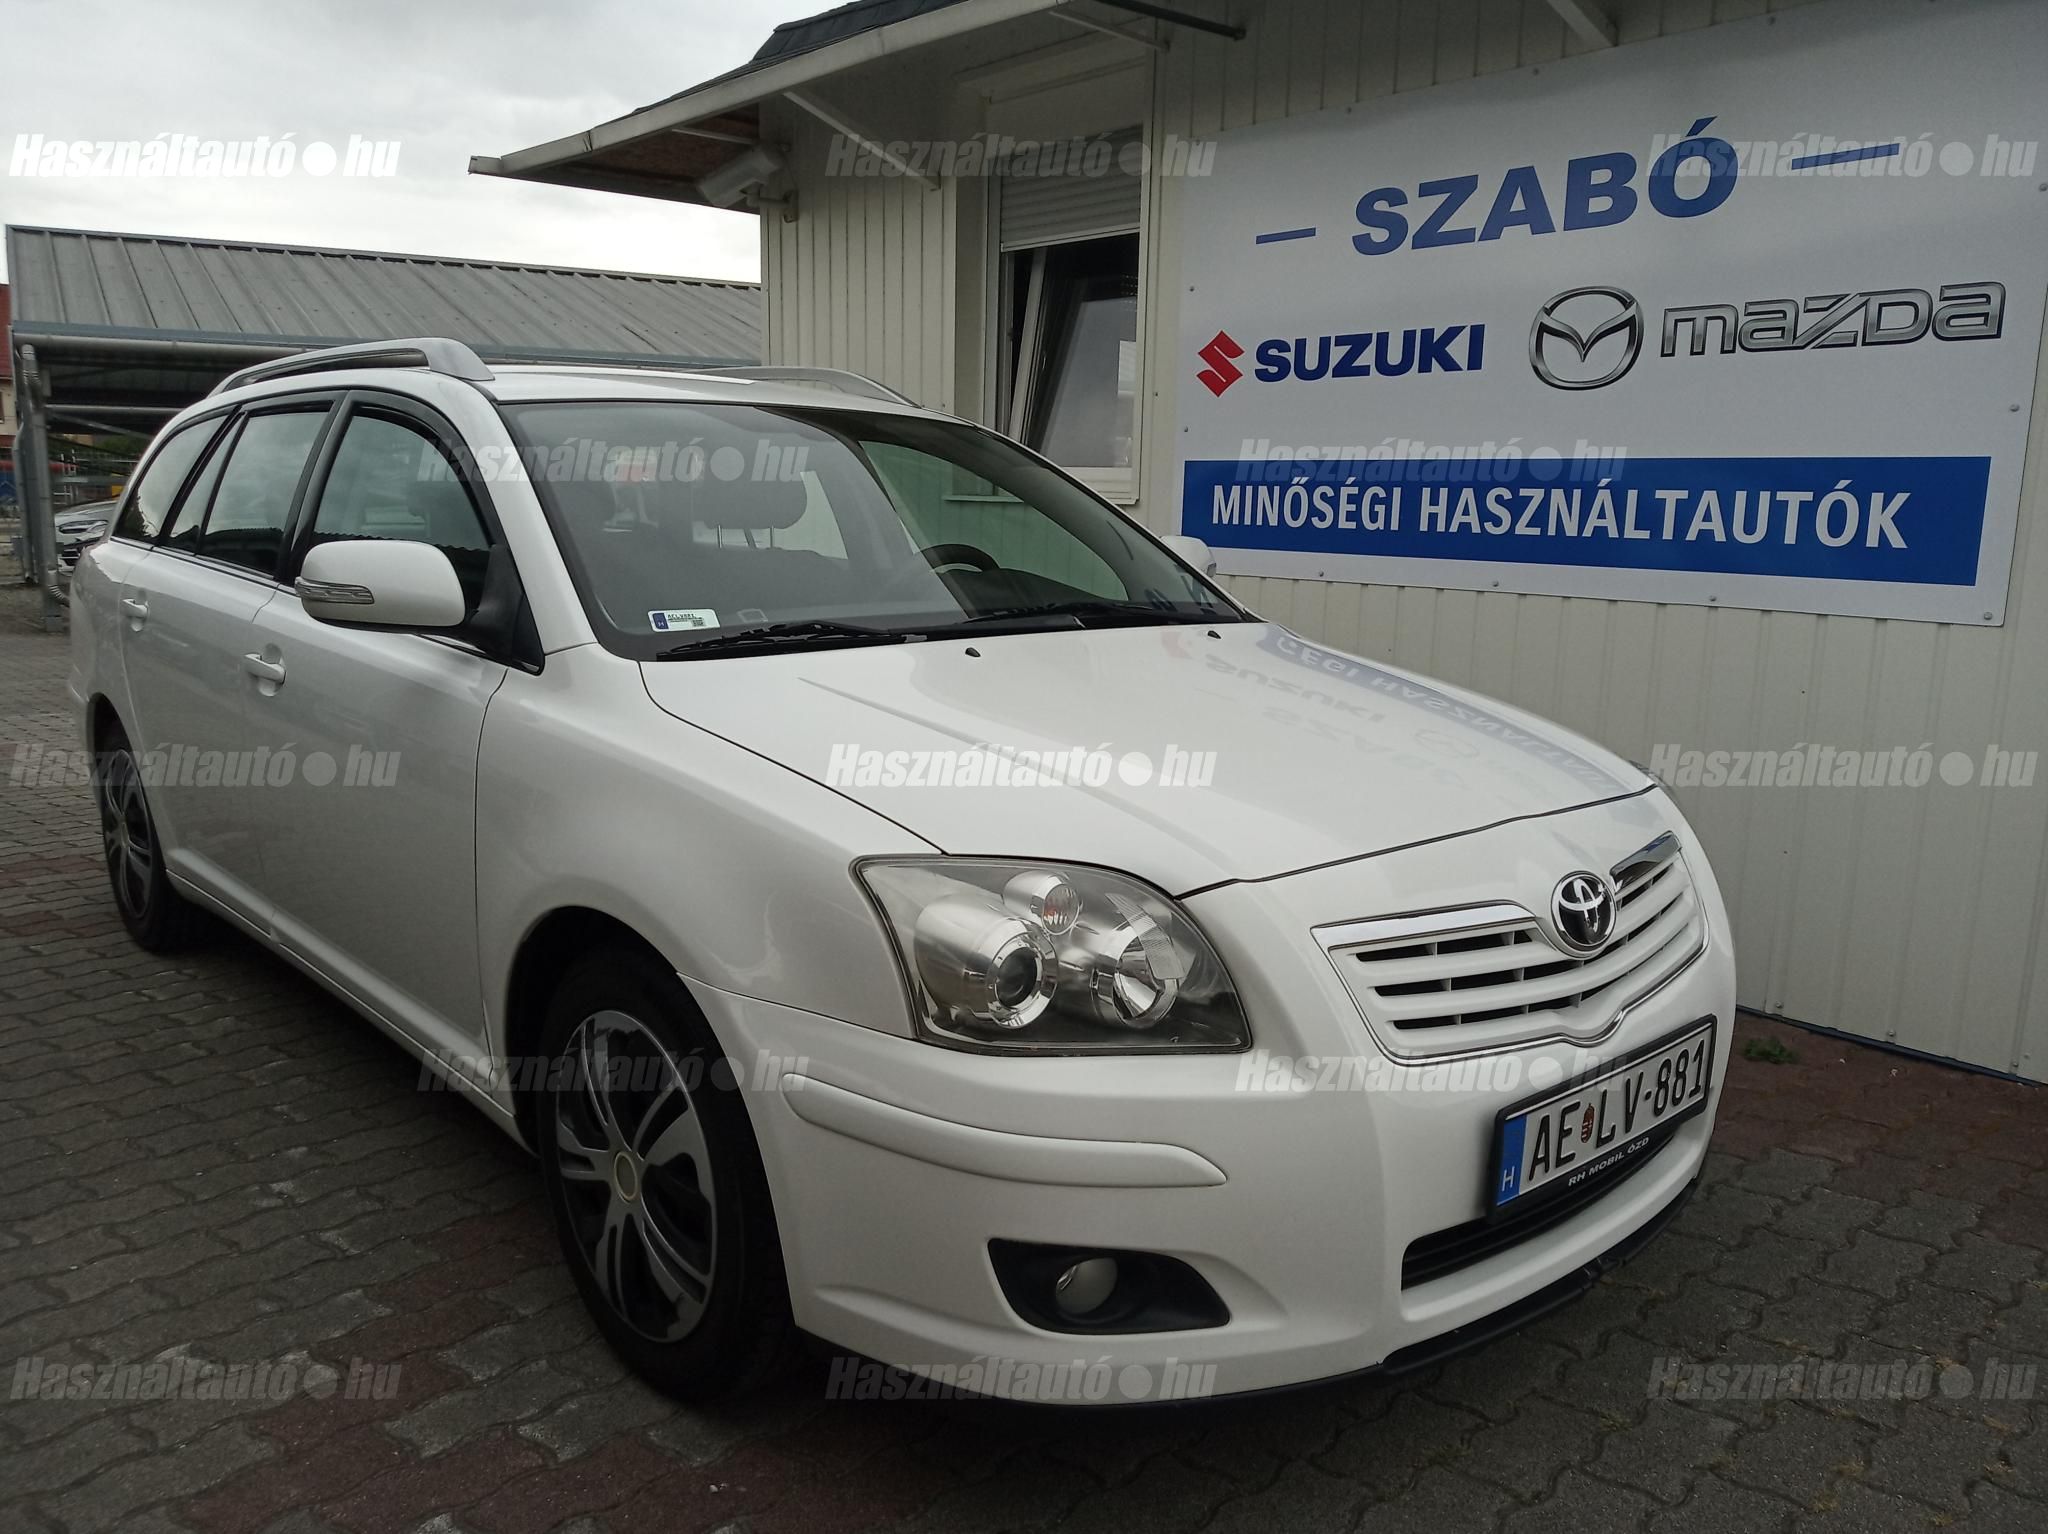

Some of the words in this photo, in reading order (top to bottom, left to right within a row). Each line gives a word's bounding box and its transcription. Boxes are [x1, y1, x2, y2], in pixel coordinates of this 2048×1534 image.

[1352, 116, 1739, 255] SZABÓ
[1254, 323, 1487, 383] SUZUKI
[1212, 477, 1401, 531] MINŐSÉGI
[1419, 478, 1911, 549] HASZNÁLTAUTÓK
[1528, 1101, 1582, 1181] AE
[1568, 1171, 1586, 1187] RH
[1588, 1152, 1625, 1176] MOBIL
[1627, 1137, 1650, 1154] ÓZD
[1501, 1166, 1515, 1192] H
